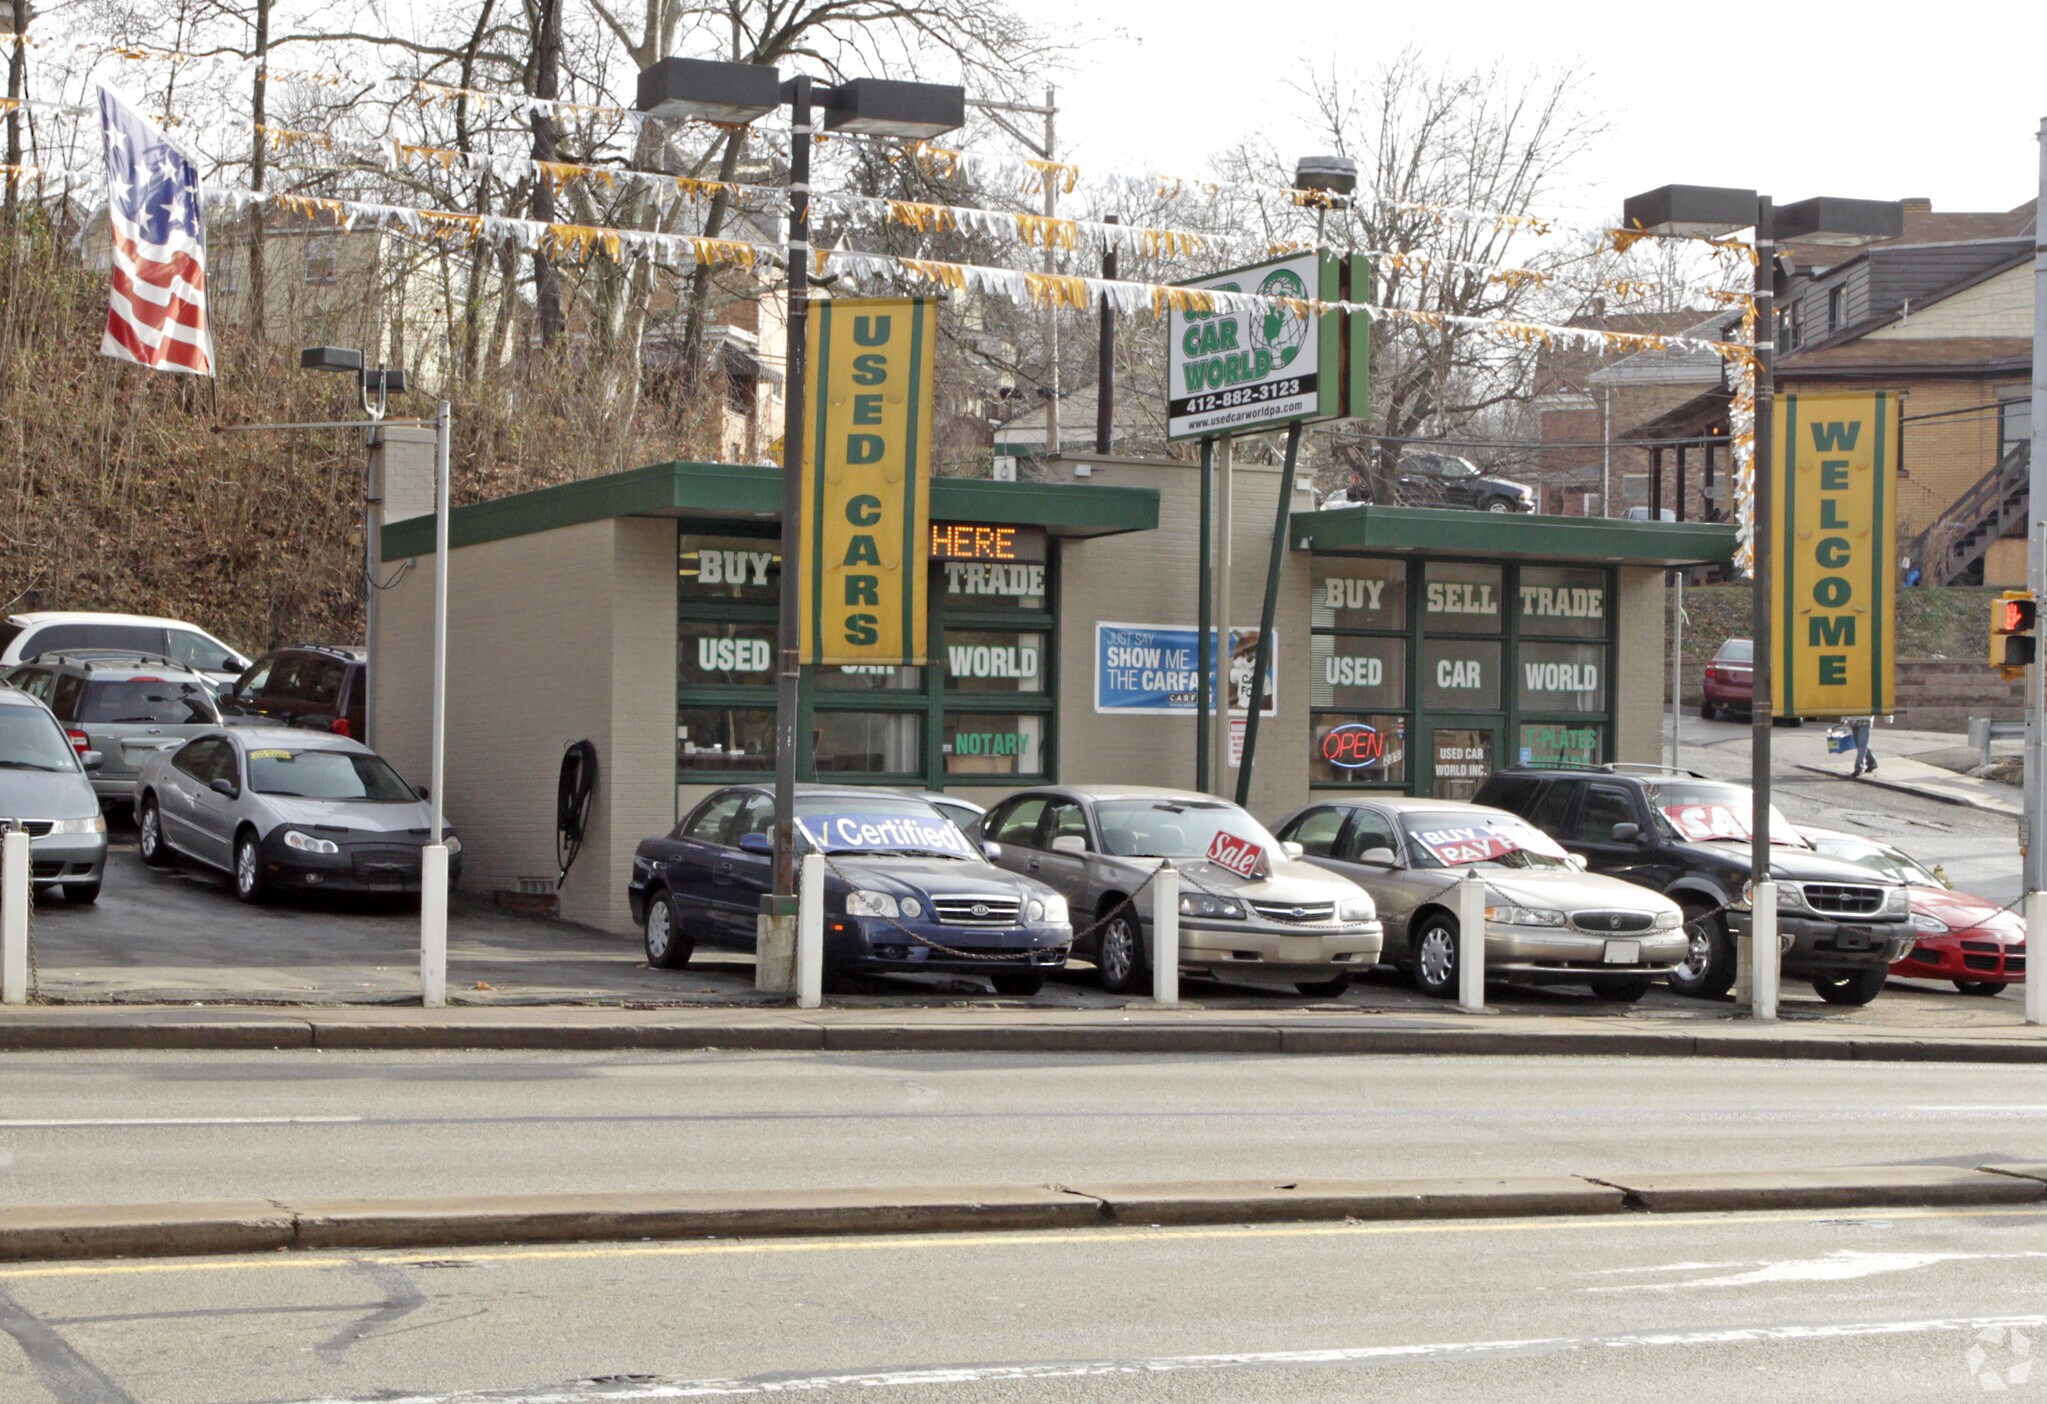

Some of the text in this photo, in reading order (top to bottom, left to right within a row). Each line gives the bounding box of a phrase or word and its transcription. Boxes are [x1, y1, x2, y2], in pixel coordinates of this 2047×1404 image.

[1183, 317, 1240, 359] CAR
[1183, 347, 1273, 394] WORLD
[846, 315, 892, 465] USED
[1186, 379, 1300, 413] 412-882-3123
[1188, 401, 1303, 430] www.usedcarworldpa.com
[932, 525, 1016, 559] HERE
[1808, 420, 1862, 686] WELCOME
[698, 549, 1046, 596] BUY TRADE
[842, 494, 882, 646] CARS
[1325, 578, 1603, 618] BUY SELL TRADE
[1107, 631, 1154, 646] JUST SAY
[699, 637, 1038, 678] USED WORLD
[1107, 646, 1191, 670] SHOW ME
[1325, 656, 1598, 691] USED CAR WORLD
[1107, 669, 1138, 691] THE
[955, 732, 1029, 756] NOTARY
[1323, 732, 1384, 759] OPEN
[1440, 747, 1484, 760] USED CAR
[1525, 727, 1597, 750] T-PLATES
[1435, 764, 1488, 776] WORLD INC.
[836, 817, 961, 851] Certified
[1422, 827, 1476, 845] BUY
[1441, 839, 1492, 861] PAY
[1207, 833, 1256, 872] Sale
